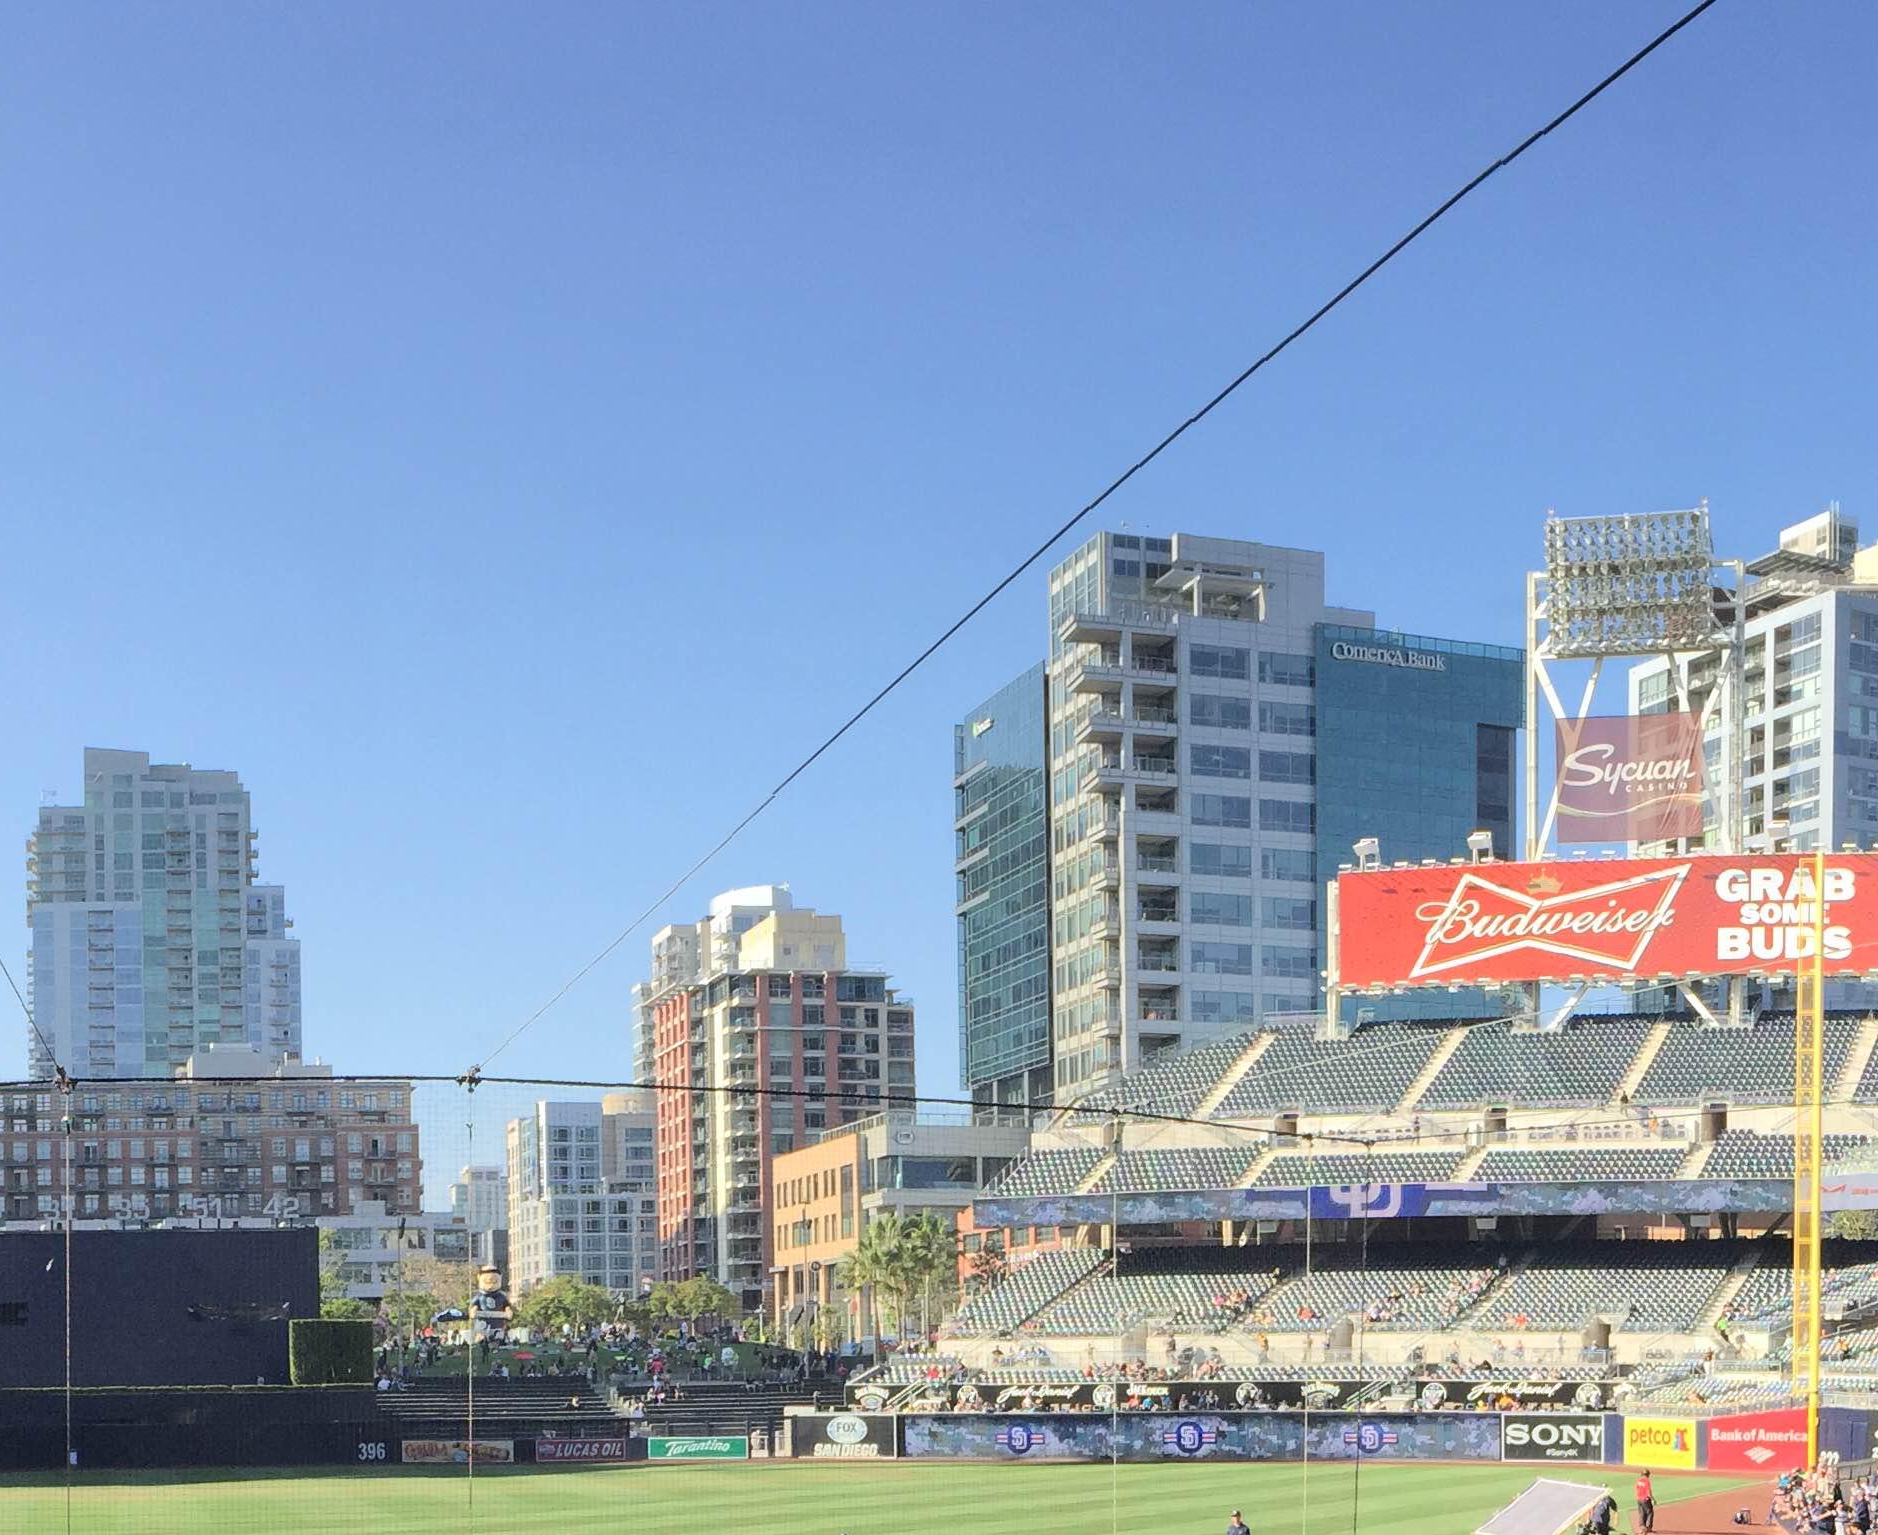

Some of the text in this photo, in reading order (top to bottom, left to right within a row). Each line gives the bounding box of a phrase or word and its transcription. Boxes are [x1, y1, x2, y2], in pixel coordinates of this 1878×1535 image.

[1407, 653, 1446, 671] Bank
[1563, 744, 1697, 796] Sycuan
[1625, 781, 1688, 794] CASINO
[1716, 868, 1856, 903] GRAB
[1415, 896, 1676, 947] Budweiser
[1717, 924, 1852, 961] BUDS
[192, 1197, 222, 1219] 51
[262, 1197, 300, 1219] 42
[836, 1421, 858, 1435] FOX
[1506, 1423, 1603, 1445] SONY
[1630, 1427, 1671, 1447] petco
[1711, 1428, 1808, 1442] Bank of America
[358, 1442, 386, 1461] 396
[555, 1440, 624, 1458] LUCAS OIL
[665, 1439, 731, 1458] Tarantino
[813, 1442, 879, 1458] SAN DIEGO
